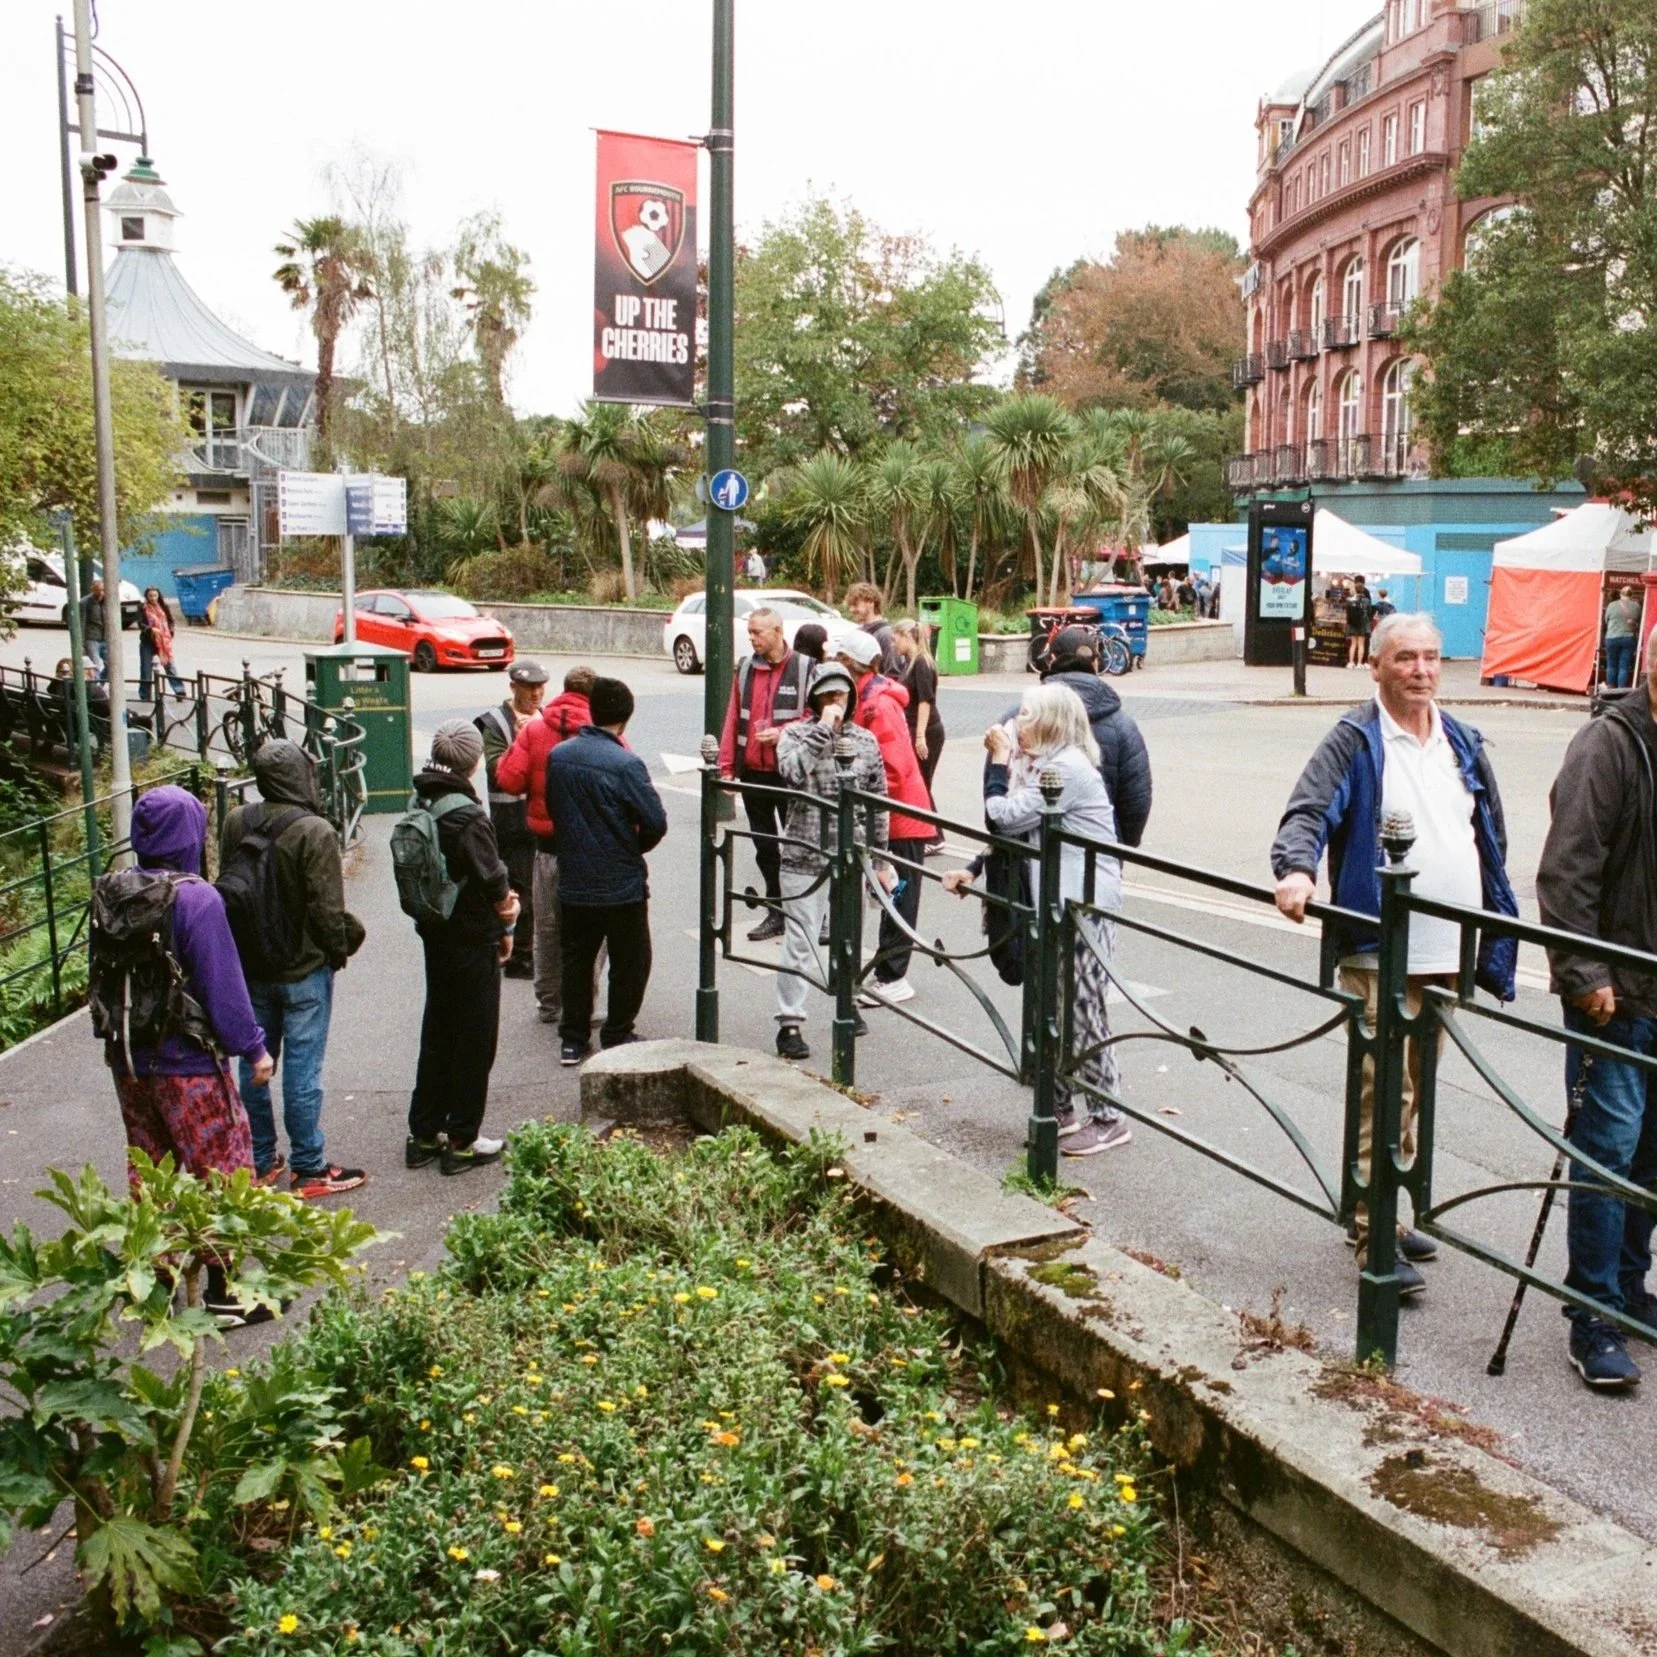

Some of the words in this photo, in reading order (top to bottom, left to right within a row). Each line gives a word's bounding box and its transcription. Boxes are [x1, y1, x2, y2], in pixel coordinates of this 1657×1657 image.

[614, 185, 628, 193] AFC
[615, 294, 641, 327] UP
[642, 297, 678, 330] THE
[601, 327, 689, 365] CHERRIES
